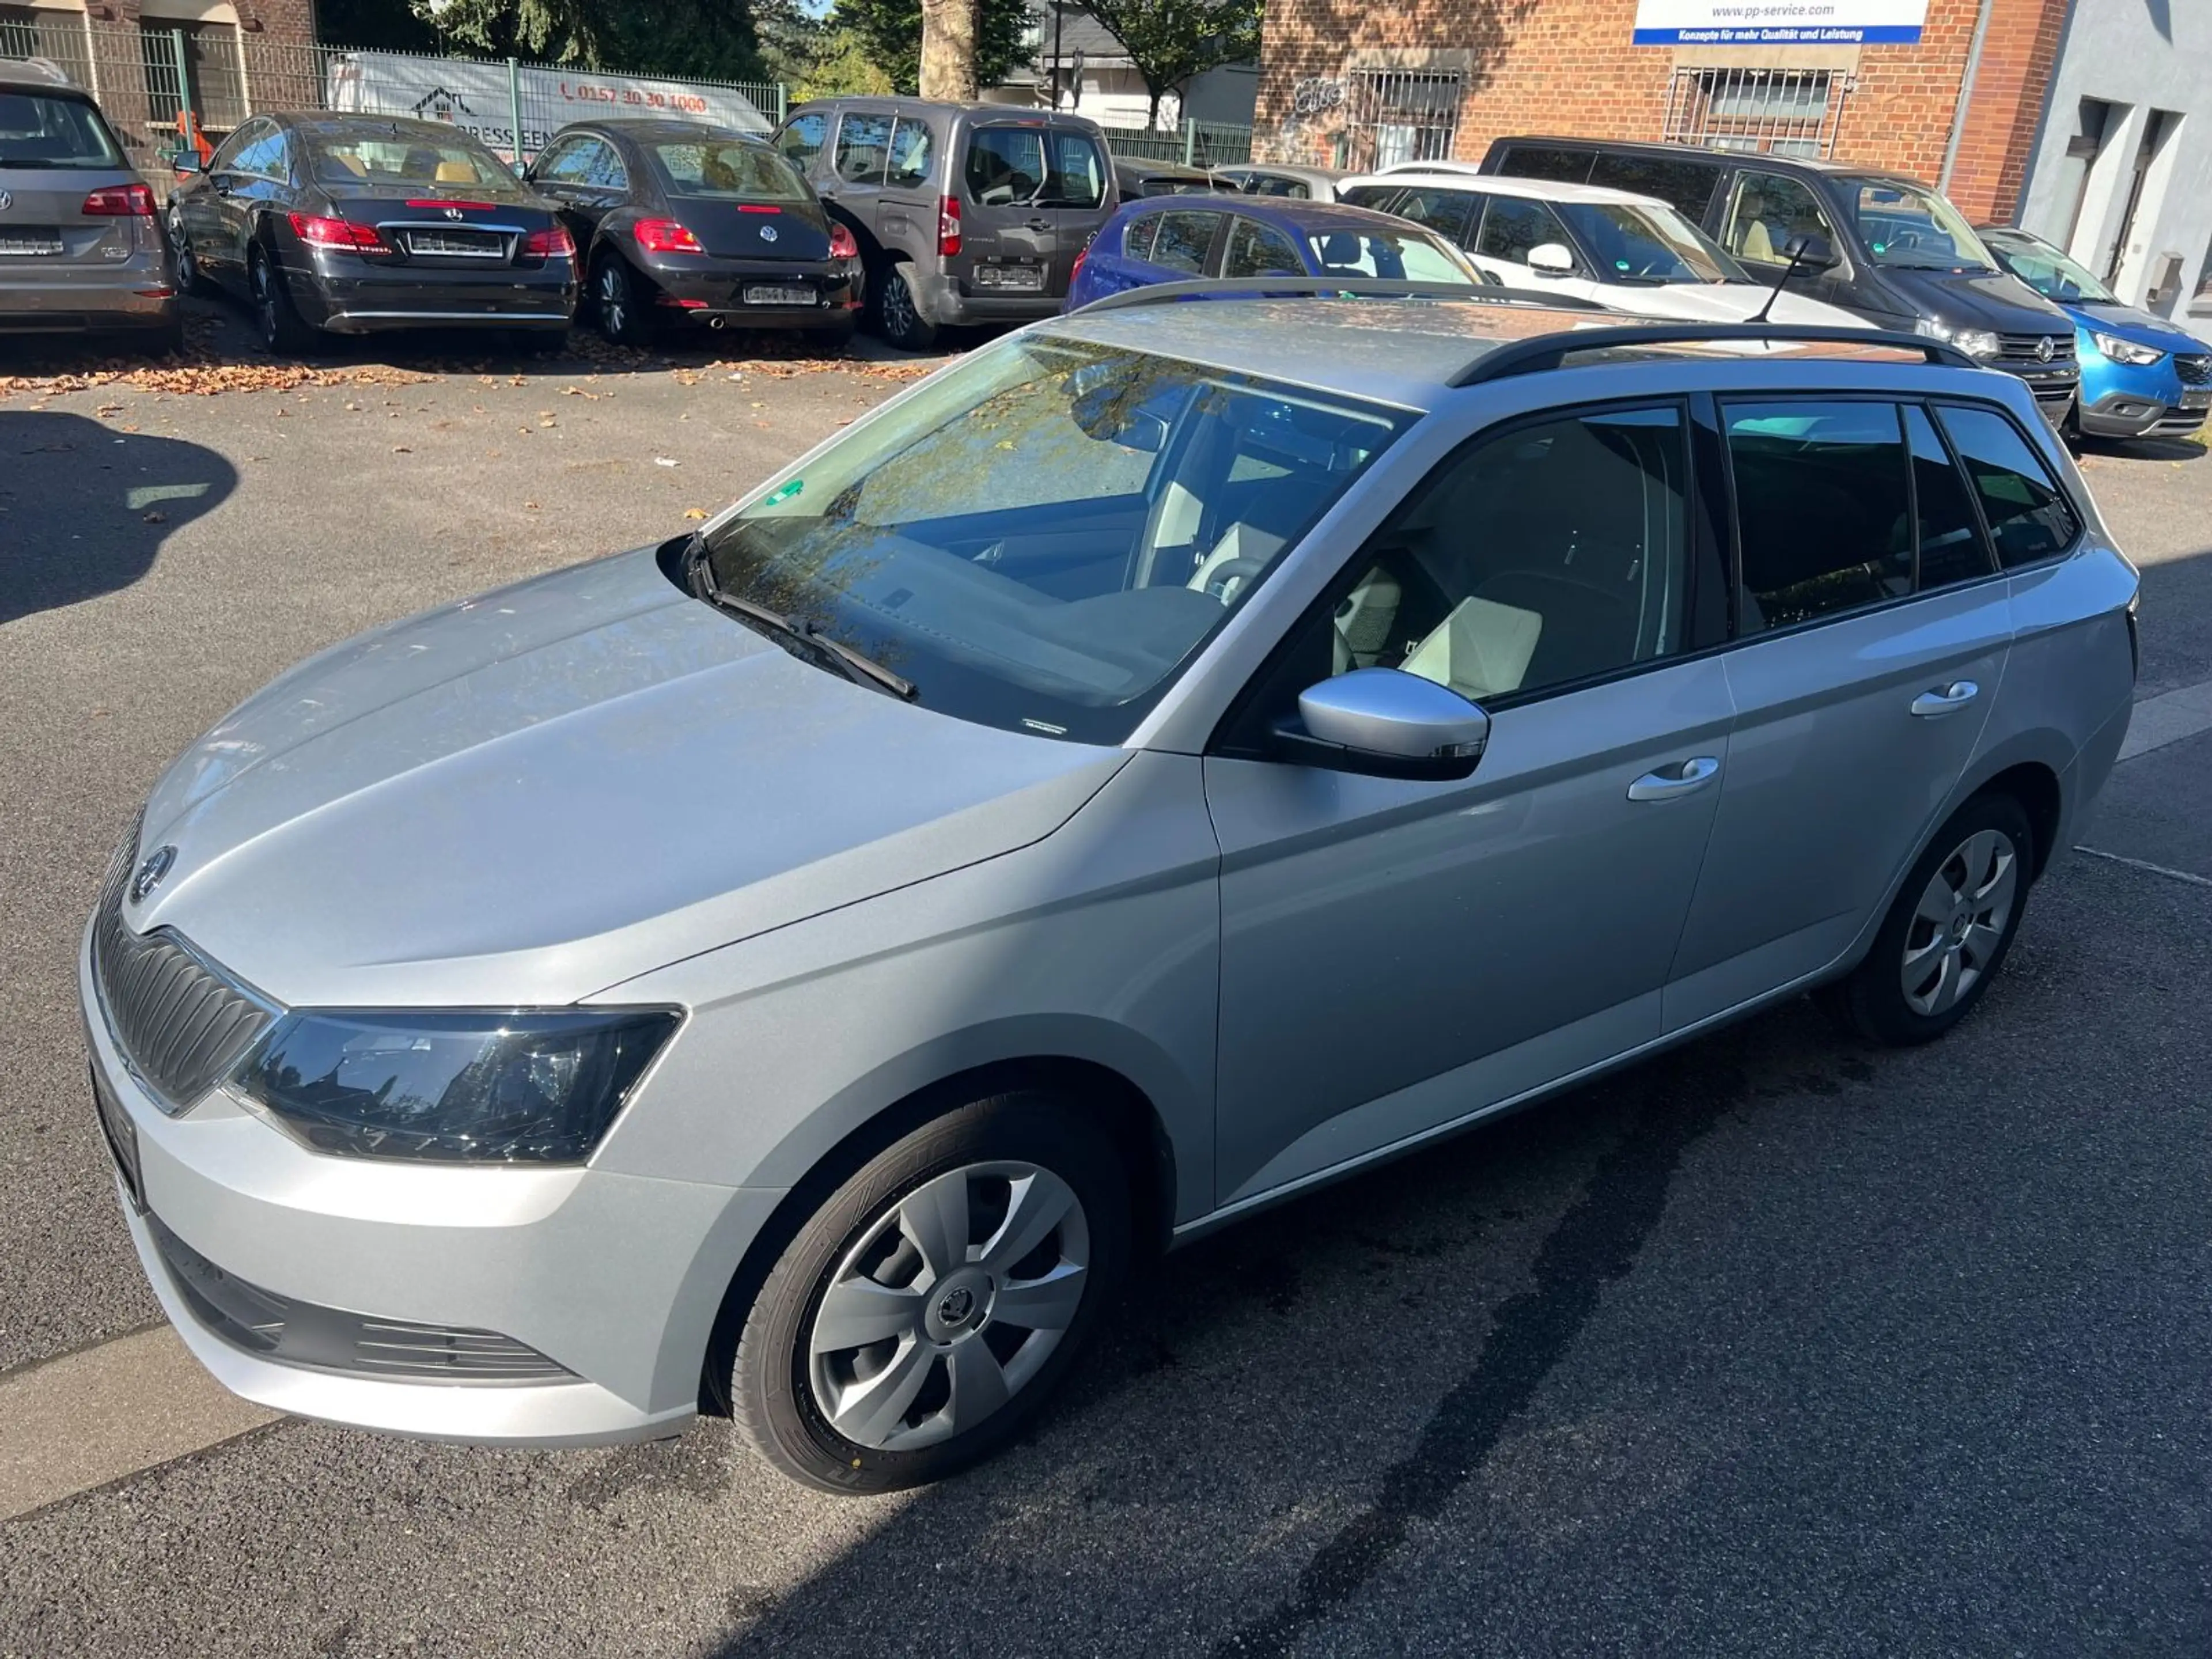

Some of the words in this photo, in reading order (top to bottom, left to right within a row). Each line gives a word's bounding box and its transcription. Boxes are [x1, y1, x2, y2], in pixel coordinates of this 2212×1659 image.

[1712, 3, 1835, 19] www.pp-service.com
[1678, 29, 1718, 42] Konzepte
[1720, 29, 1733, 40] für
[1735, 29, 1759, 40] mehr
[1761, 28, 1798, 40] Qualität
[1800, 29, 1818, 40] und
[1820, 29, 1863, 41] Leistung
[670, 94, 706, 112] 1000
